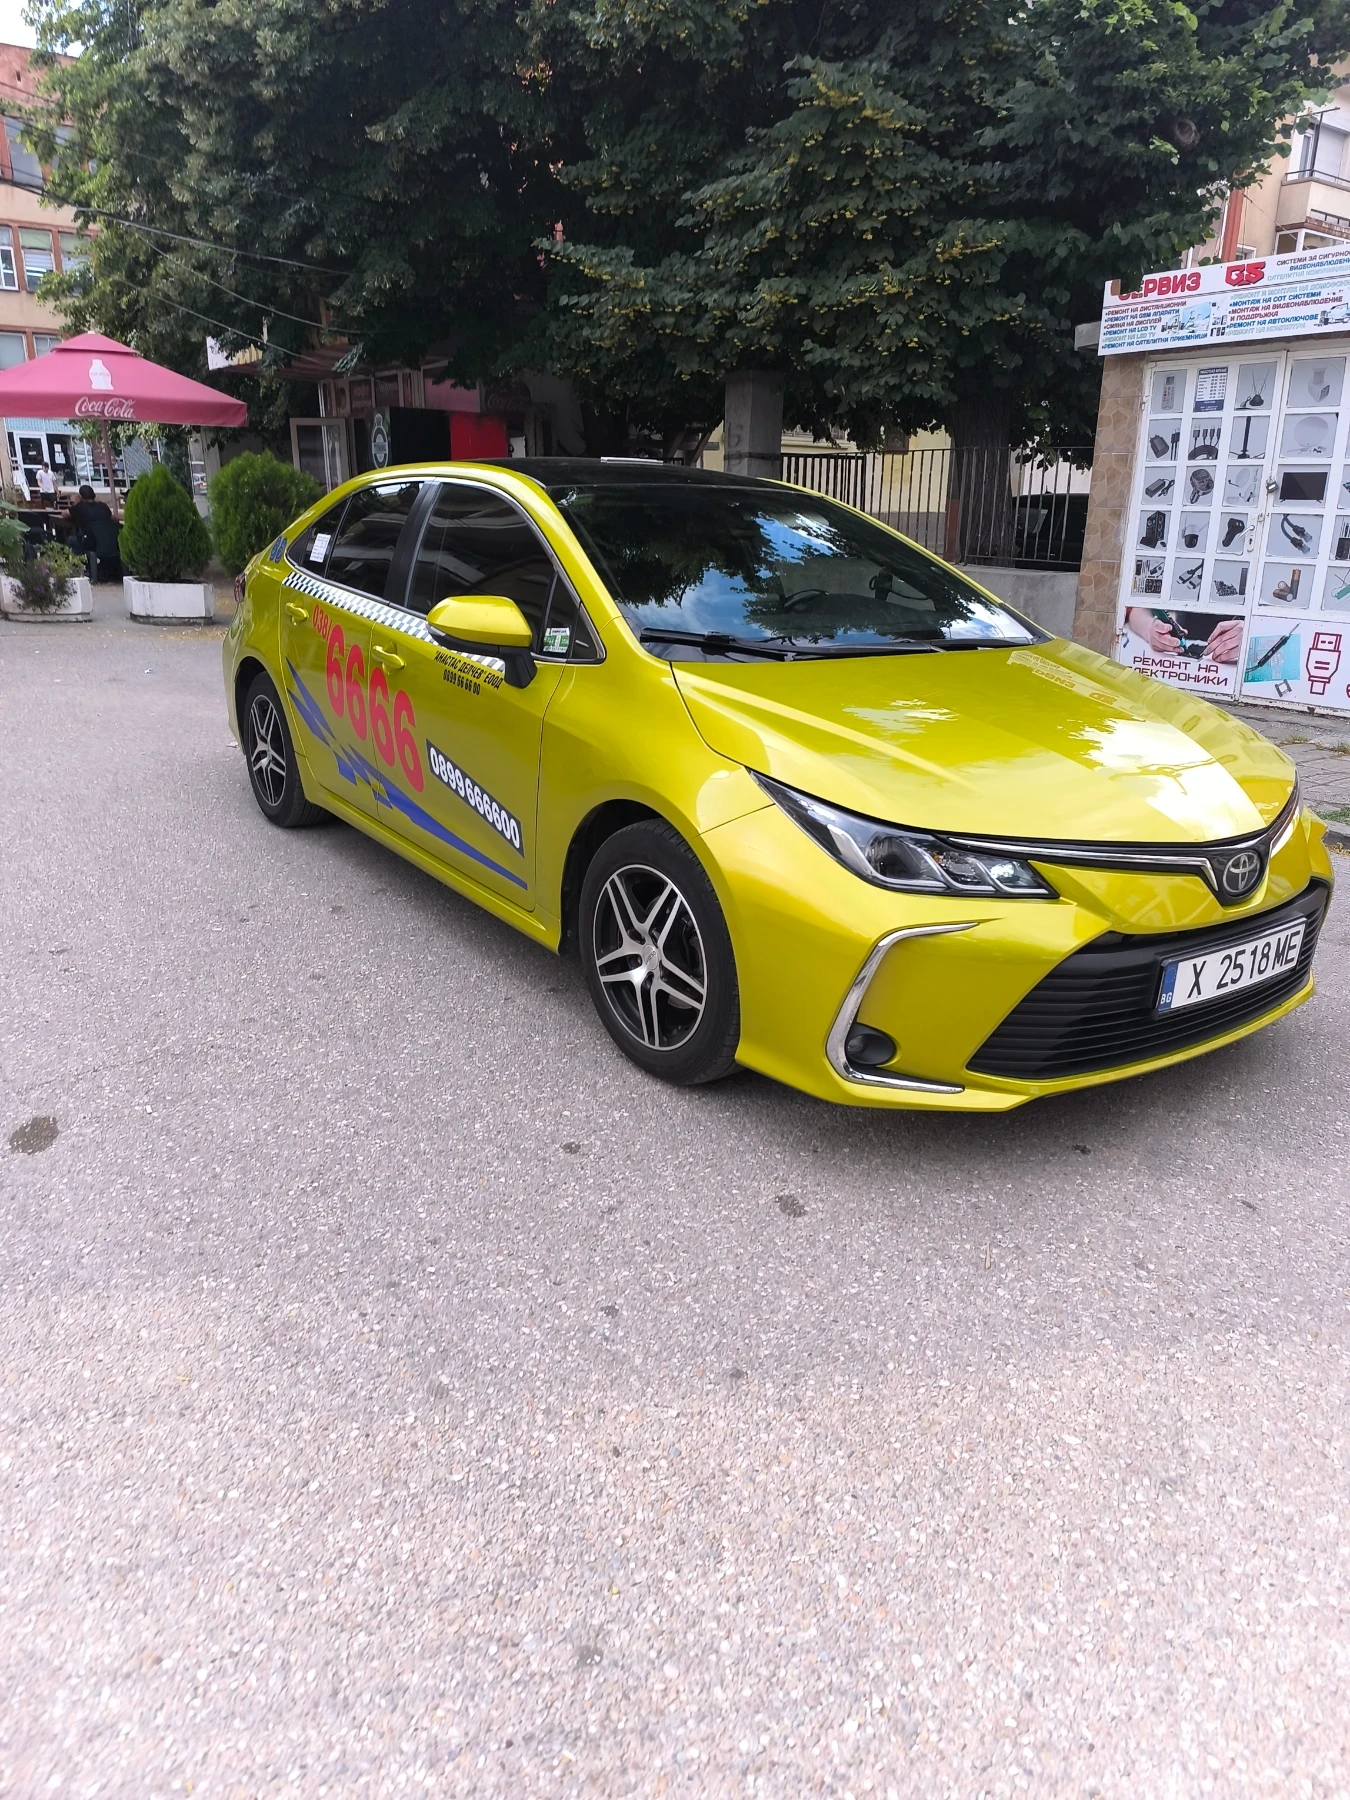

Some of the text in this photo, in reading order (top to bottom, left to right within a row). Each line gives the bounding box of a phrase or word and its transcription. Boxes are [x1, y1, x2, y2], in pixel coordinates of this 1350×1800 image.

[1276, 256, 1307, 266] СИСТЕМИ
[1225, 261, 1266, 287] GS
[1118, 272, 1201, 301] РВИЗ
[1232, 299, 1261, 307] МОНТАЖ
[1288, 290, 1322, 300] СИСТЕМИ
[1232, 306, 1260, 314] МОНТАЖ
[1272, 296, 1343, 310] ВИДЕОНАБЛЮДЕНИЕ
[1108, 308, 1129, 316] РЕМОНТ
[1152, 308, 1180, 317] АПАРАТИ
[1236, 310, 1279, 321] ПОДДРЪЖКА
[1134, 316, 1162, 326] ДИСПЛЕЙ
[1229, 320, 1256, 328] РЕМОНТ
[1268, 314, 1319, 324] АВТОКЛЮЧОВЕ
[1106, 328, 1128, 336] РЕМОНТ
[1104, 342, 1126, 350] РЕМОНТ
[1136, 336, 1168, 346] САТЕЛИТНИ
[1133, 656, 1219, 674] РЕМОНТ НА
[443, 668, 456, 684] 0899
[472, 682, 480, 696] 00
[484, 672, 504, 690] ЕООД
[1128, 666, 1228, 686] ЛЕКТРОНИКИ
[1187, 930, 1300, 999] X 2518 ME
[1160, 992, 1172, 1004] BG
